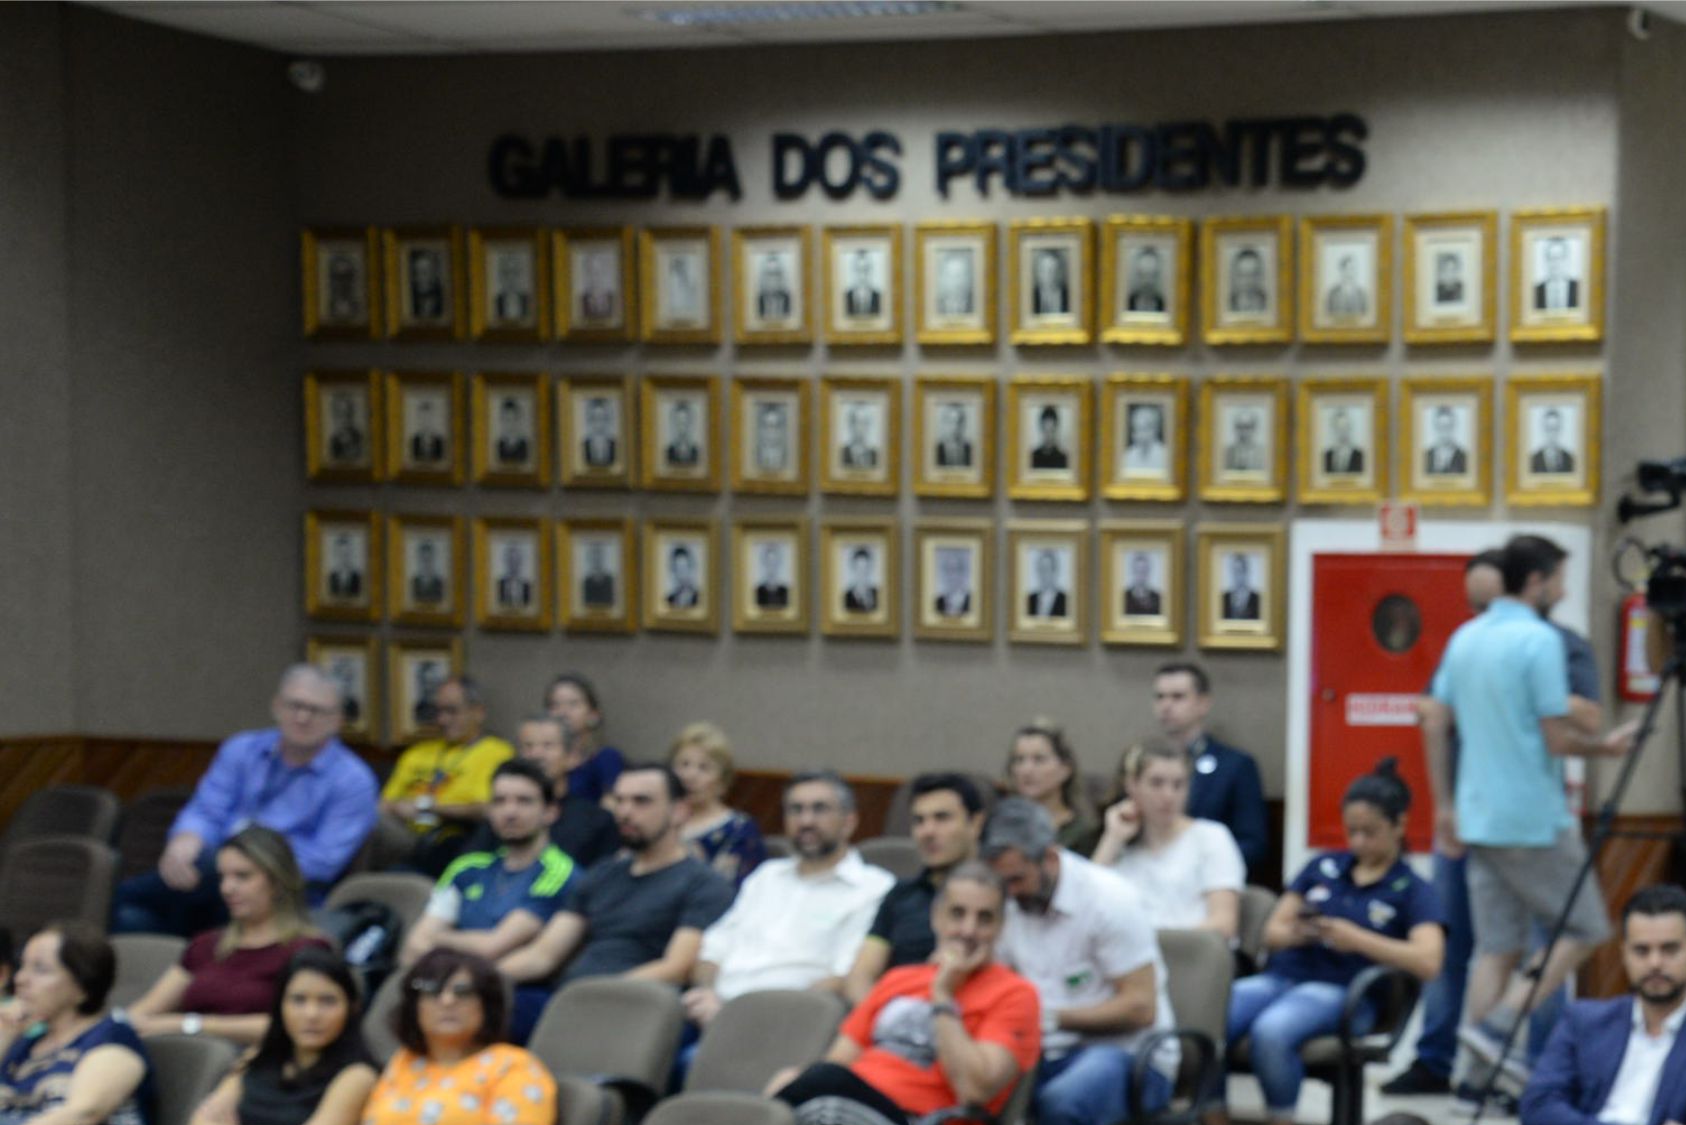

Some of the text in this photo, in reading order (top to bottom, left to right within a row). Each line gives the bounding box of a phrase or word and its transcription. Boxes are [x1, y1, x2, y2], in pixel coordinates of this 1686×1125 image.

[488, 113, 1369, 202] GALERIA DOS PRESIDENTES
